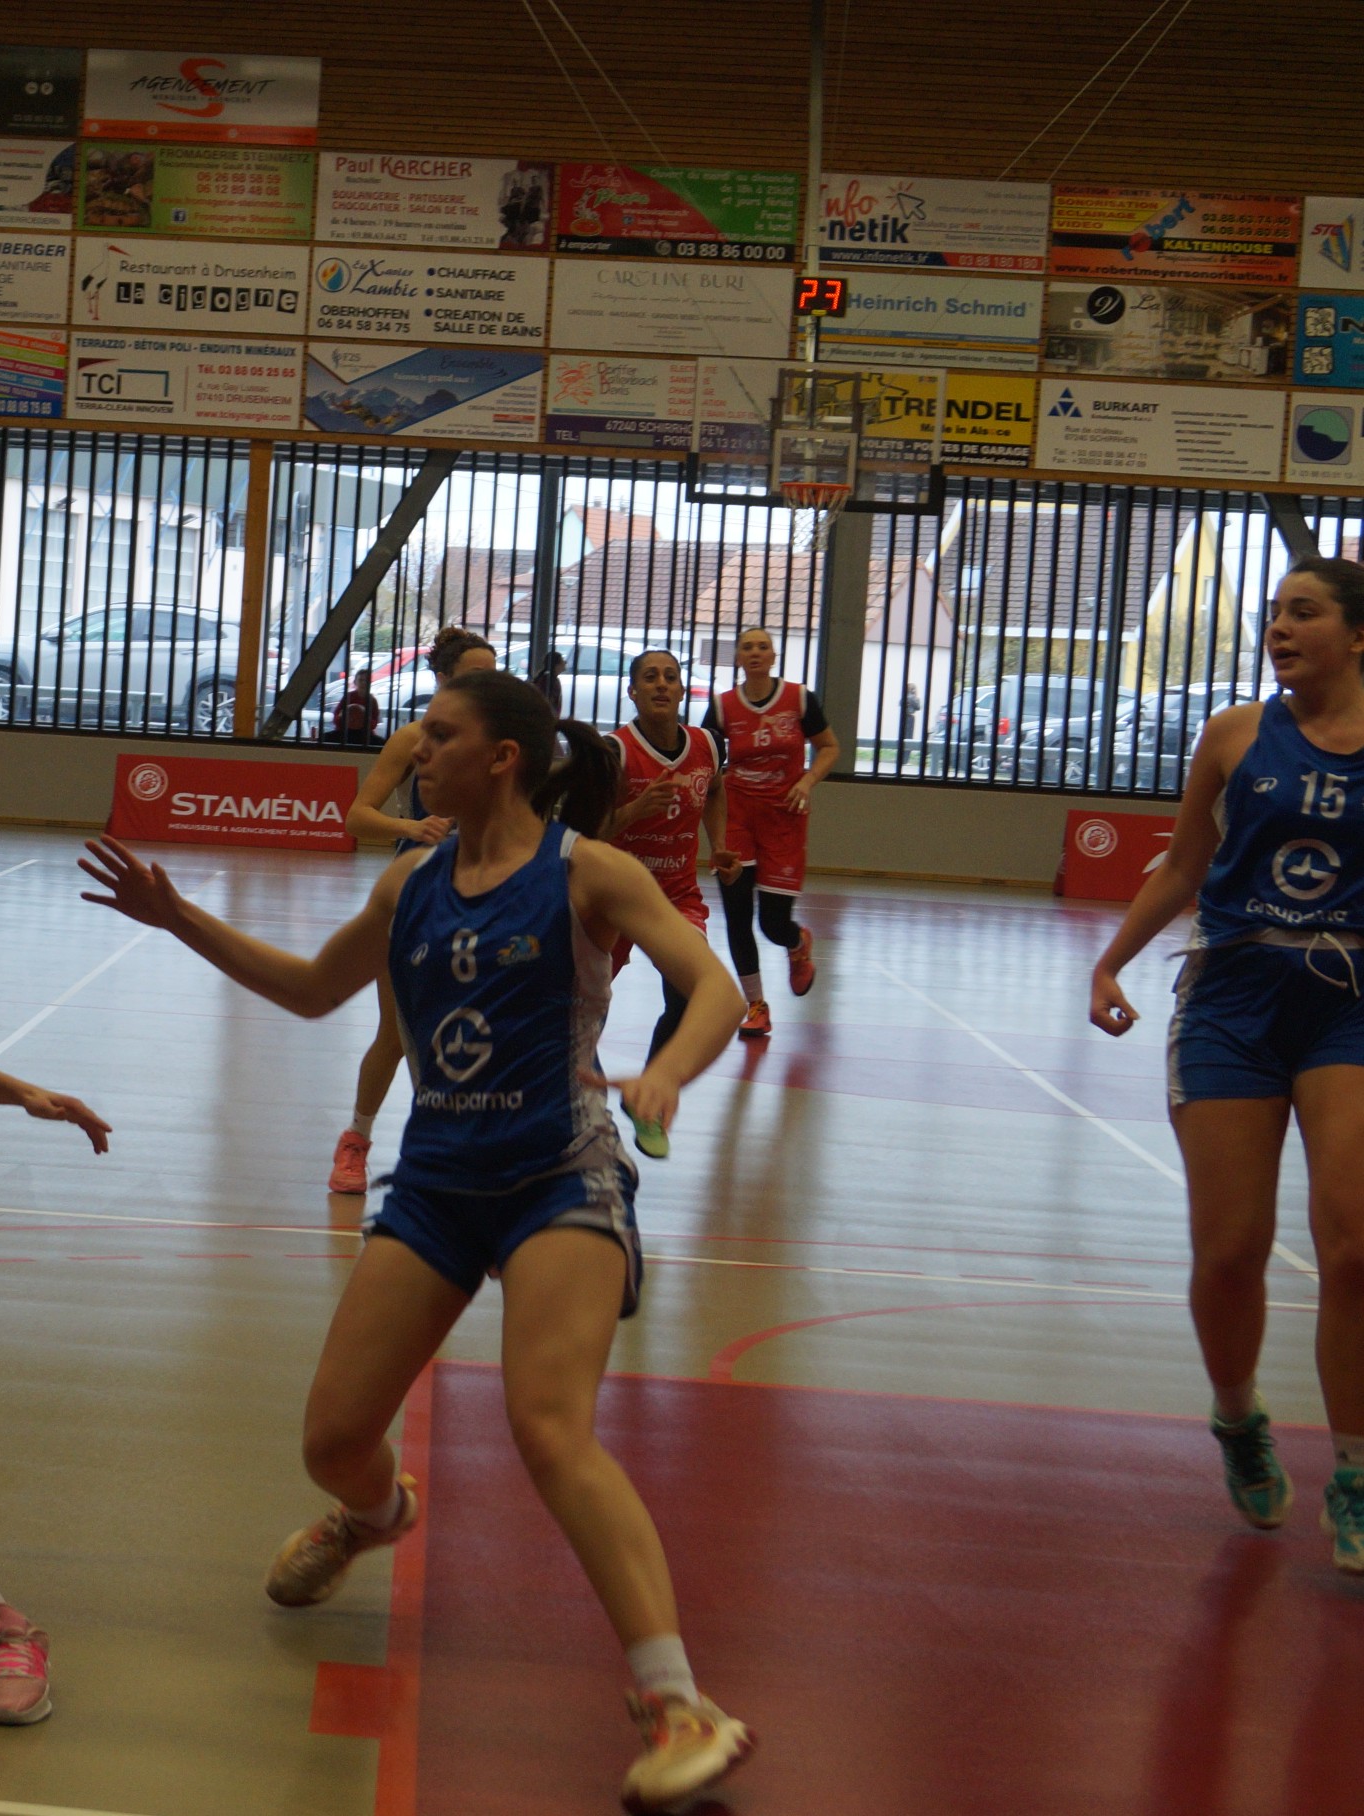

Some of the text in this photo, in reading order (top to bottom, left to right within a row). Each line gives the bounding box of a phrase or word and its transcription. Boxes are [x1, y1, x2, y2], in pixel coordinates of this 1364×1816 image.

[130, 76, 275, 95] AGENCEMENT
[160, 149, 310, 163] FROMAGERIE STEINMETZ
[336, 156, 472, 178] Paul KARCHER
[333, 190, 465, 203] BOULANGERIE PATISSERIE
[1056, 197, 1158, 209] SONORISATION
[332, 201, 399, 212] CHOCOLATIER
[408, 204, 441, 214] SALON
[444, 206, 457, 215] DE
[1056, 209, 1135, 219] ECLAIRAGE
[1056, 220, 1104, 230] VIDEO
[676, 242, 696, 256] 03
[699, 243, 718, 257] 88
[721, 244, 740, 259] 86
[743, 245, 763, 260] 00
[766, 246, 786, 261] 00
[1163, 238, 1274, 255] KALTENHOUSE
[959, 255, 973, 266] 03
[994, 257, 1013, 267] 180
[120, 260, 296, 280] Restaurant à Drusenheim
[437, 267, 516, 281] CHAUFFAGE
[350, 277, 418, 298] Lambic
[436, 287, 505, 301] SANITAIRE
[798, 278, 843, 311] 23
[117, 281, 300, 314] La cigogne
[847, 294, 1027, 317] Heinrich Schmid
[320, 304, 410, 319] OBERHOFFEN
[435, 308, 526, 323] CREATION DE
[317, 317, 411, 333] 06 84 58 34 75
[434, 321, 542, 337] SALLE DE BAINS
[76, 337, 297, 357] TERRAZZO BÉTON POLI ENDUITS MINÉRAUX
[219, 365, 232, 375] 03
[235, 365, 247, 376] 88
[250, 366, 263, 376] 05
[266, 366, 279, 377] 25
[83, 372, 122, 395] TCI
[226, 394, 292, 406] DRUSENHEIM
[1092, 400, 1158, 414] BURKART
[883, 395, 1031, 422] TRENDEL
[638, 421, 725, 436] SCHIRRHOFEN
[956, 424, 965, 434] in
[861, 439, 1030, 457] VOLETS POTES DE GARAGE
[752, 729, 772, 748] 15
[1300, 769, 1349, 820] 15
[170, 792, 344, 824] STAMÉNA
[230, 825, 288, 836] AGENCEMENT
[290, 829, 308, 837] SUR
[309, 829, 345, 839] MESURE
[451, 927, 478, 984] 8
[416, 1089, 524, 1115] Groupama
